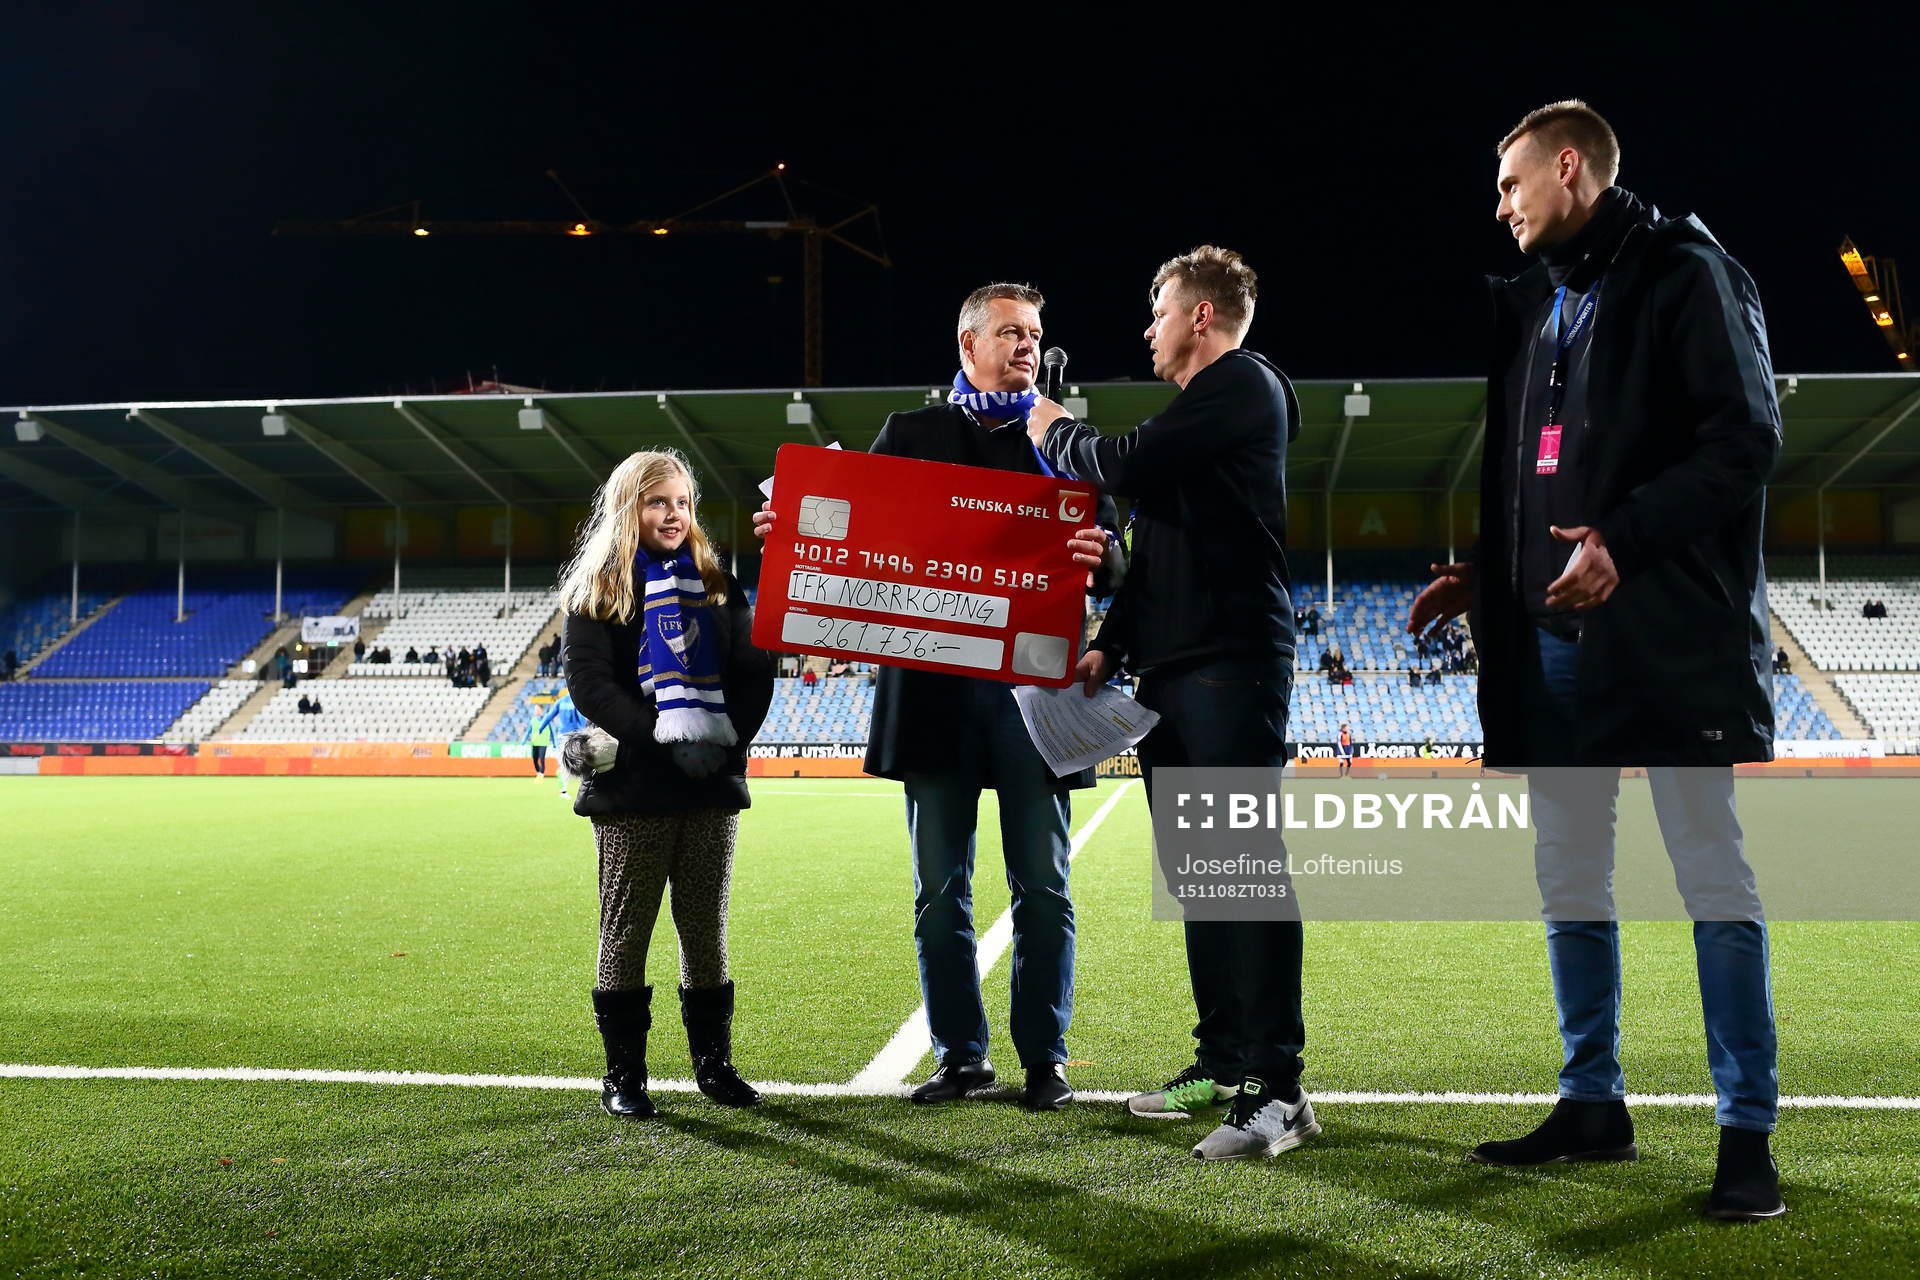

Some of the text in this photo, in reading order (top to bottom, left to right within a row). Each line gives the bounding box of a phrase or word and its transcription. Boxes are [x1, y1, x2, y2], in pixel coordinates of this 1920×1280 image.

[951, 496, 1050, 519] SVENSKA SPEL
[794, 542, 1049, 592] 4012 7496 2390 5185
[791, 572, 994, 624] IFK NORRKÖPING
[663, 619, 683, 632] IFK
[1297, 743, 1334, 758] kvm
[1359, 743, 1416, 759] LÄGGER
[1461, 745, 1474, 759] &
